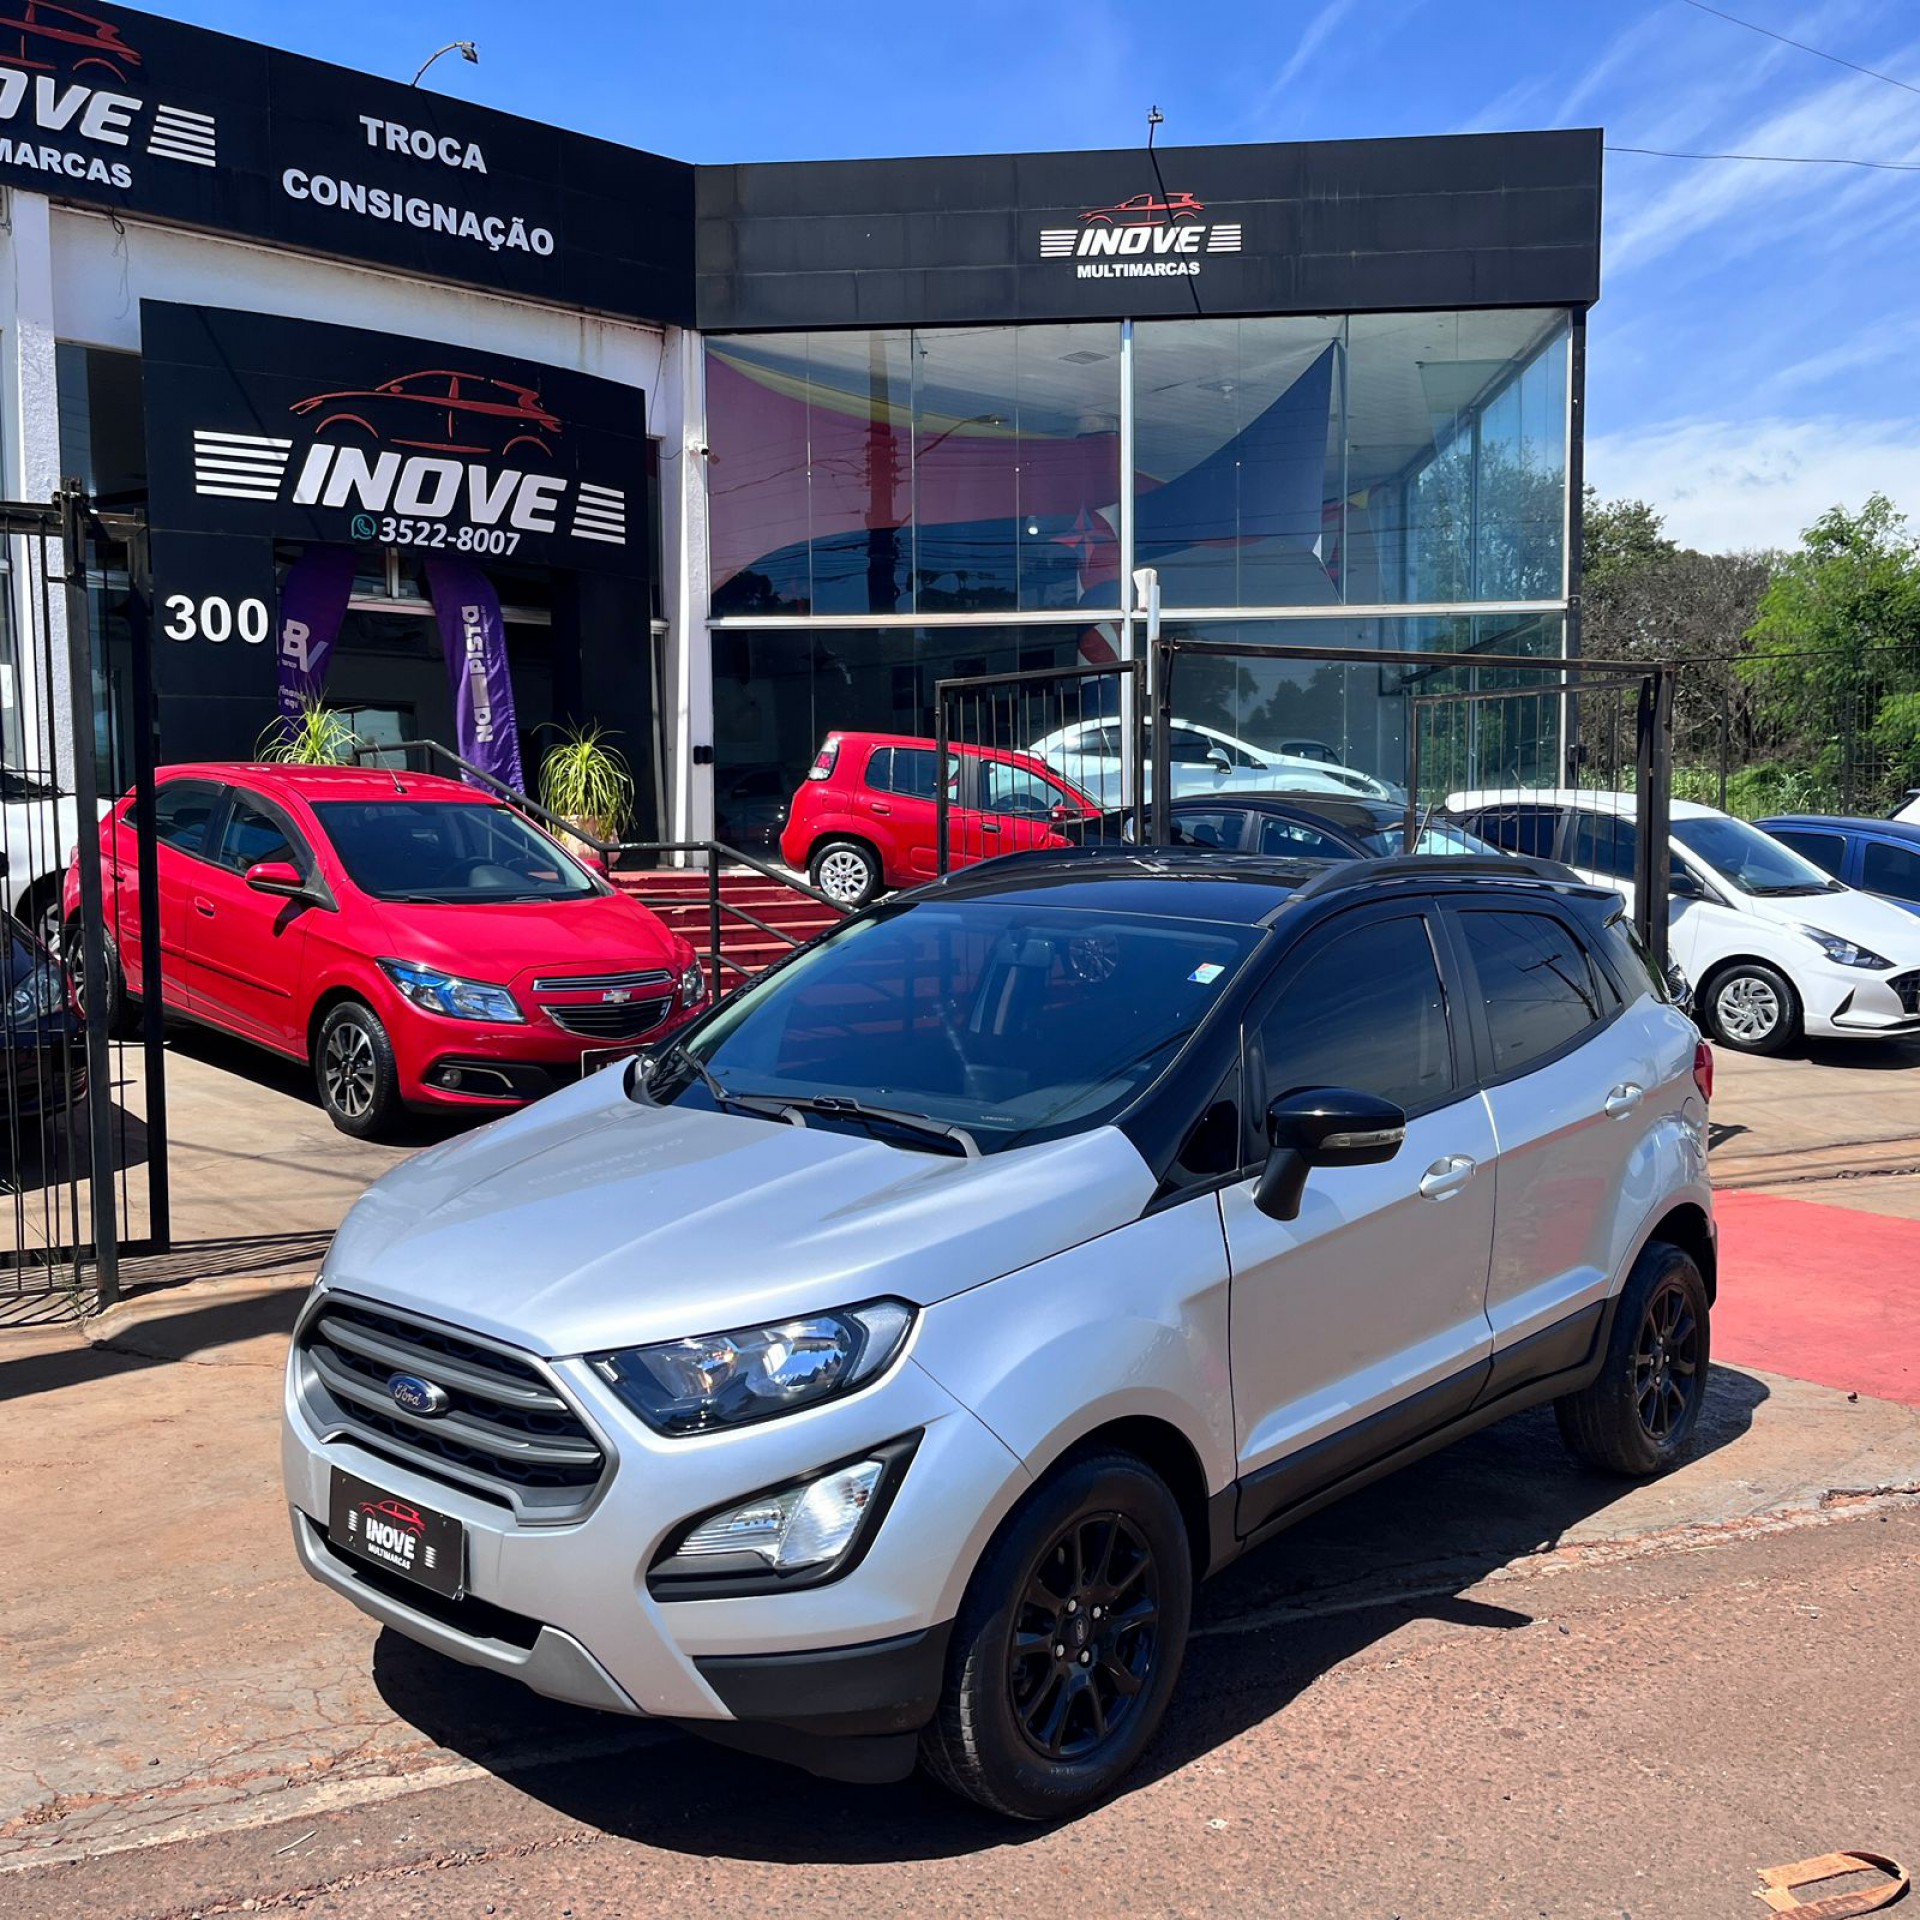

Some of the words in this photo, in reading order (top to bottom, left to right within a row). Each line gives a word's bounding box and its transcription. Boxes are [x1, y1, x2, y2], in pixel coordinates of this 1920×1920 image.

[359, 114, 488, 174] TROCA
[282, 168, 554, 256] CONSIGNAÇÃO
[1077, 226, 1206, 256] INOVE
[1076, 261, 1201, 279] MULTIMARCAS
[292, 443, 568, 534] INOVE
[378, 516, 521, 556] 3522-8007
[163, 593, 269, 644] 300
[394, 1382, 421, 1406] Ford
[365, 1517, 416, 1560] INOVE
[367, 1542, 411, 1571] MULTIMARCAS
